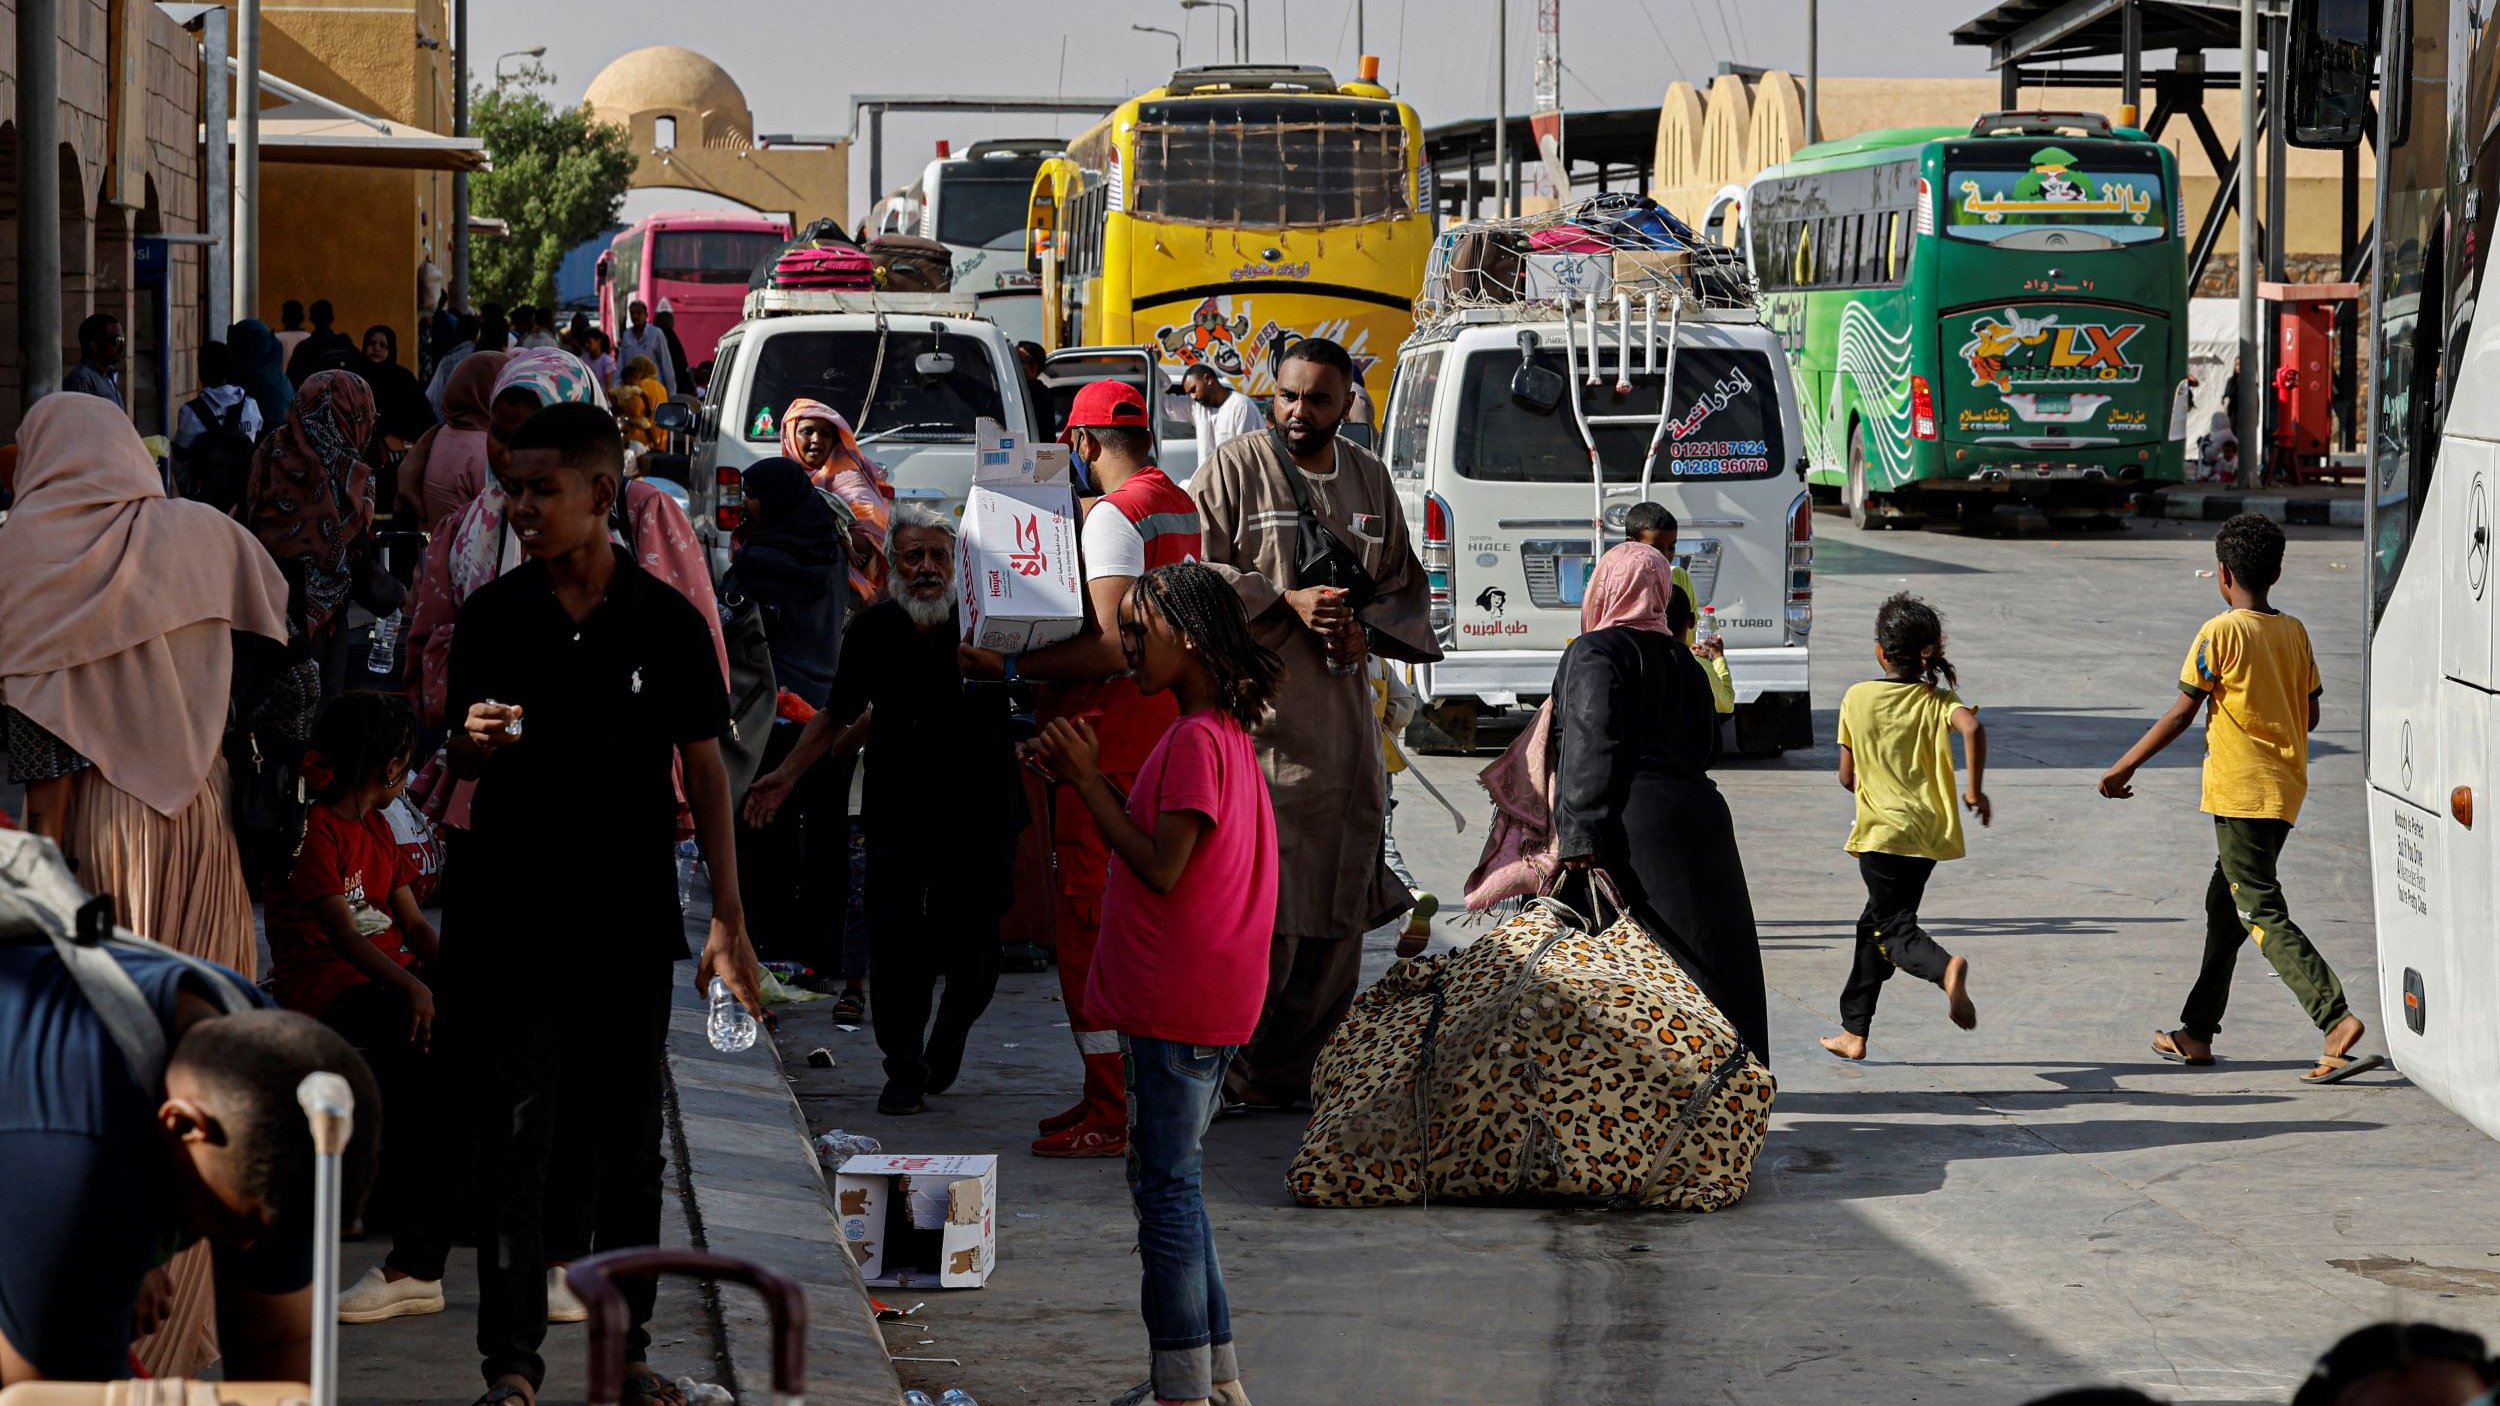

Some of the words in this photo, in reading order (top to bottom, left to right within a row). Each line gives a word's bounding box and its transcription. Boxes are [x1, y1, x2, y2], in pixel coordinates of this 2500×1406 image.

[1242, 320, 1281, 381] NUMBER
[1996, 367, 2140, 382] PRECISION
[1666, 365, 1752, 441] إماراتية
[1671, 441, 1768, 458] 0122187624
[1671, 459, 1768, 475] 0128896079
[1009, 512, 1048, 577] حياة
[1468, 542, 1511, 552] HIACE
[988, 569, 1002, 597] Hayat
[1730, 619, 1773, 628] TURBO
[2395, 809, 2407, 835] Nobody
[2414, 843, 2422, 867] Drive
